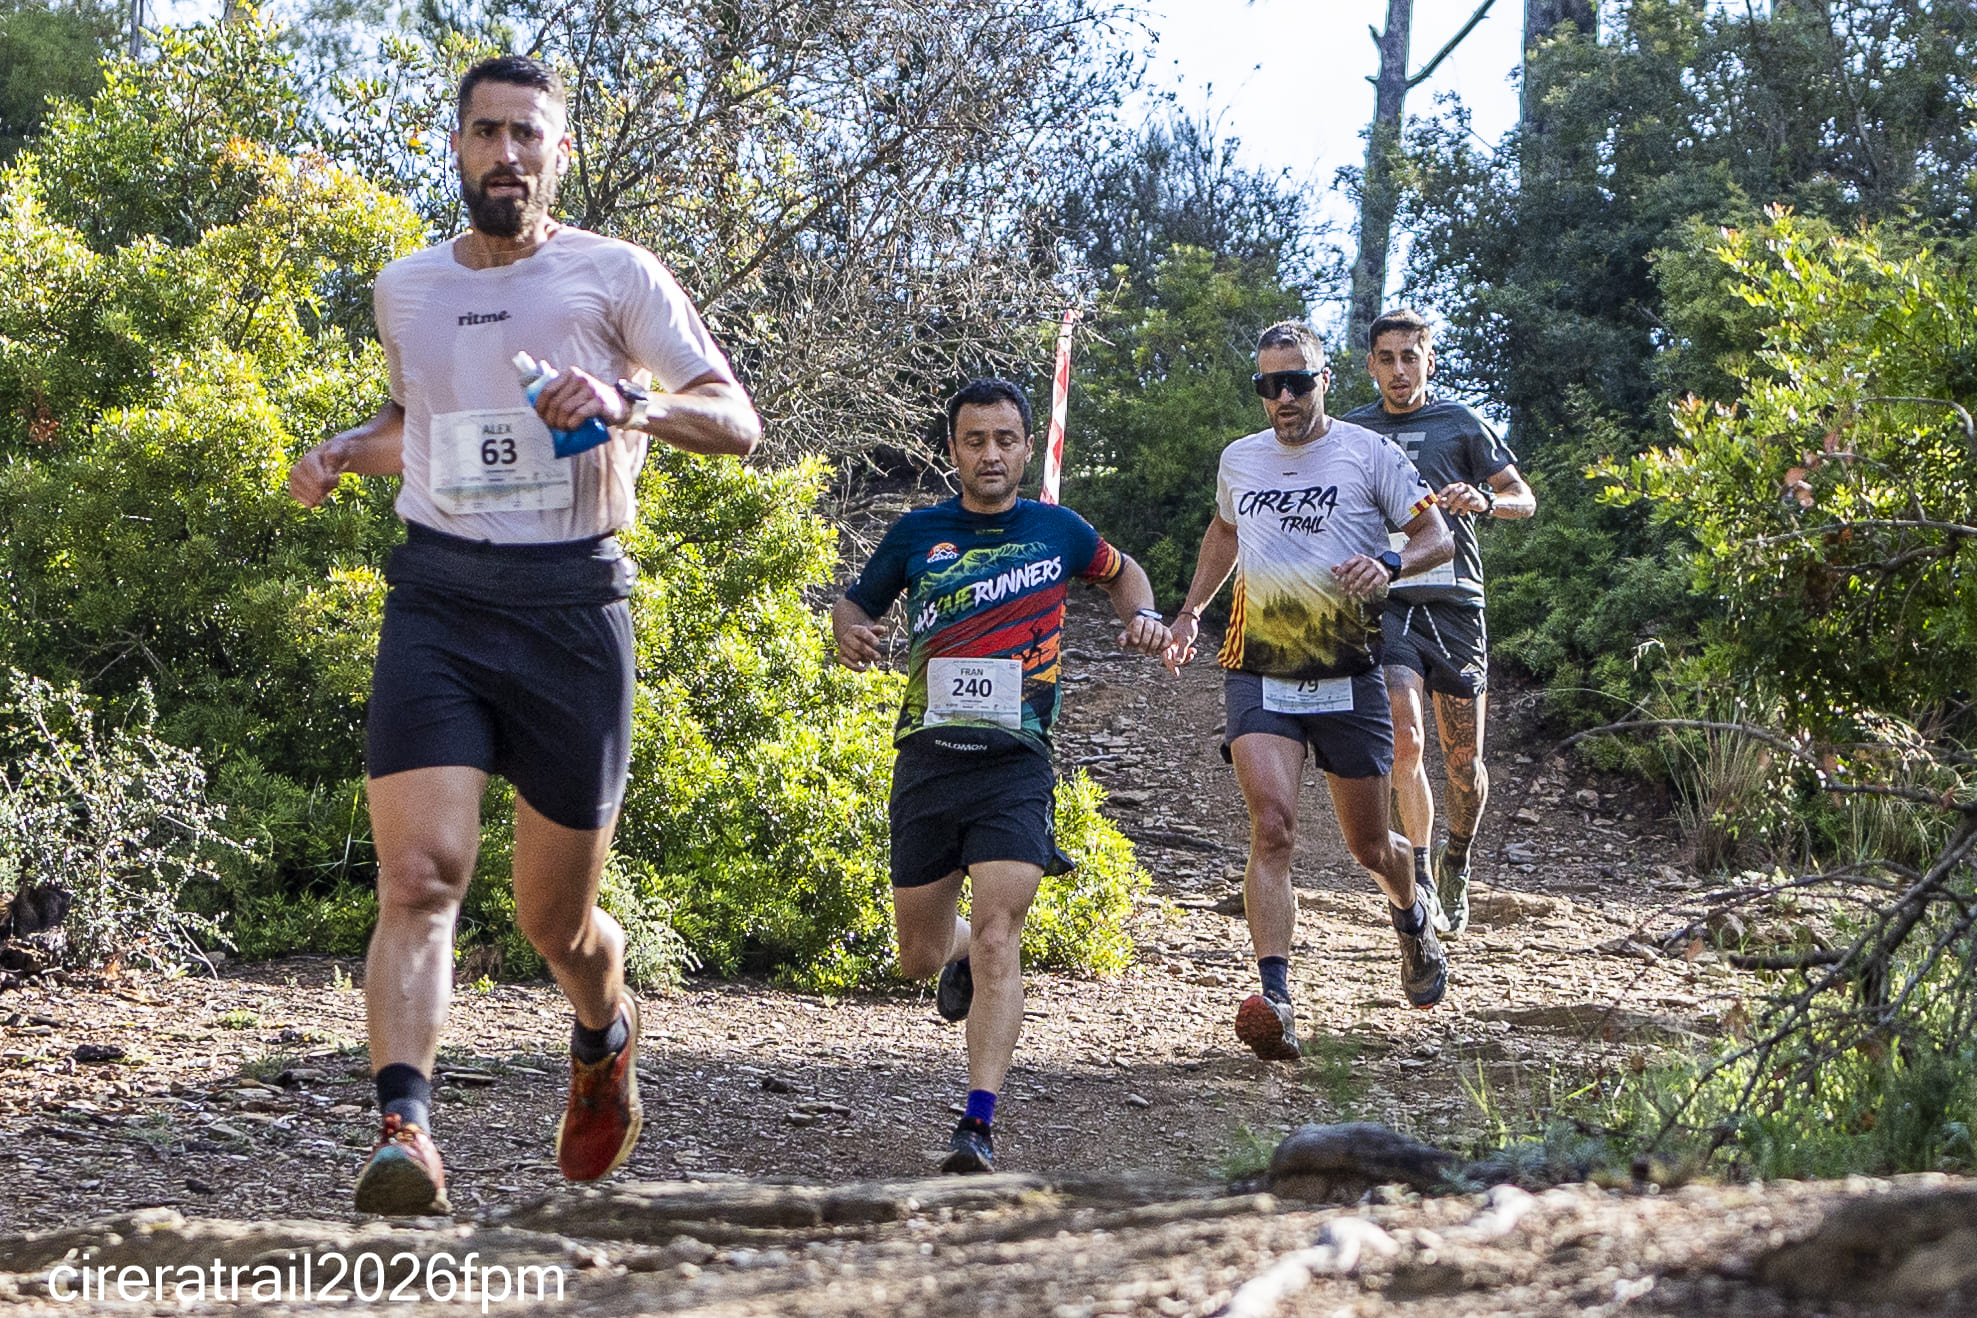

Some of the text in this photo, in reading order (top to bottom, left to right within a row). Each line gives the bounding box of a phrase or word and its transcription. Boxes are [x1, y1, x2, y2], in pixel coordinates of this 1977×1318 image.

[483, 424, 512, 434] ALEX
[481, 438, 517, 465] 63
[1280, 515, 1326, 536] TRAIL
[960, 668, 983, 676] FRAN
[952, 678, 992, 697] 240
